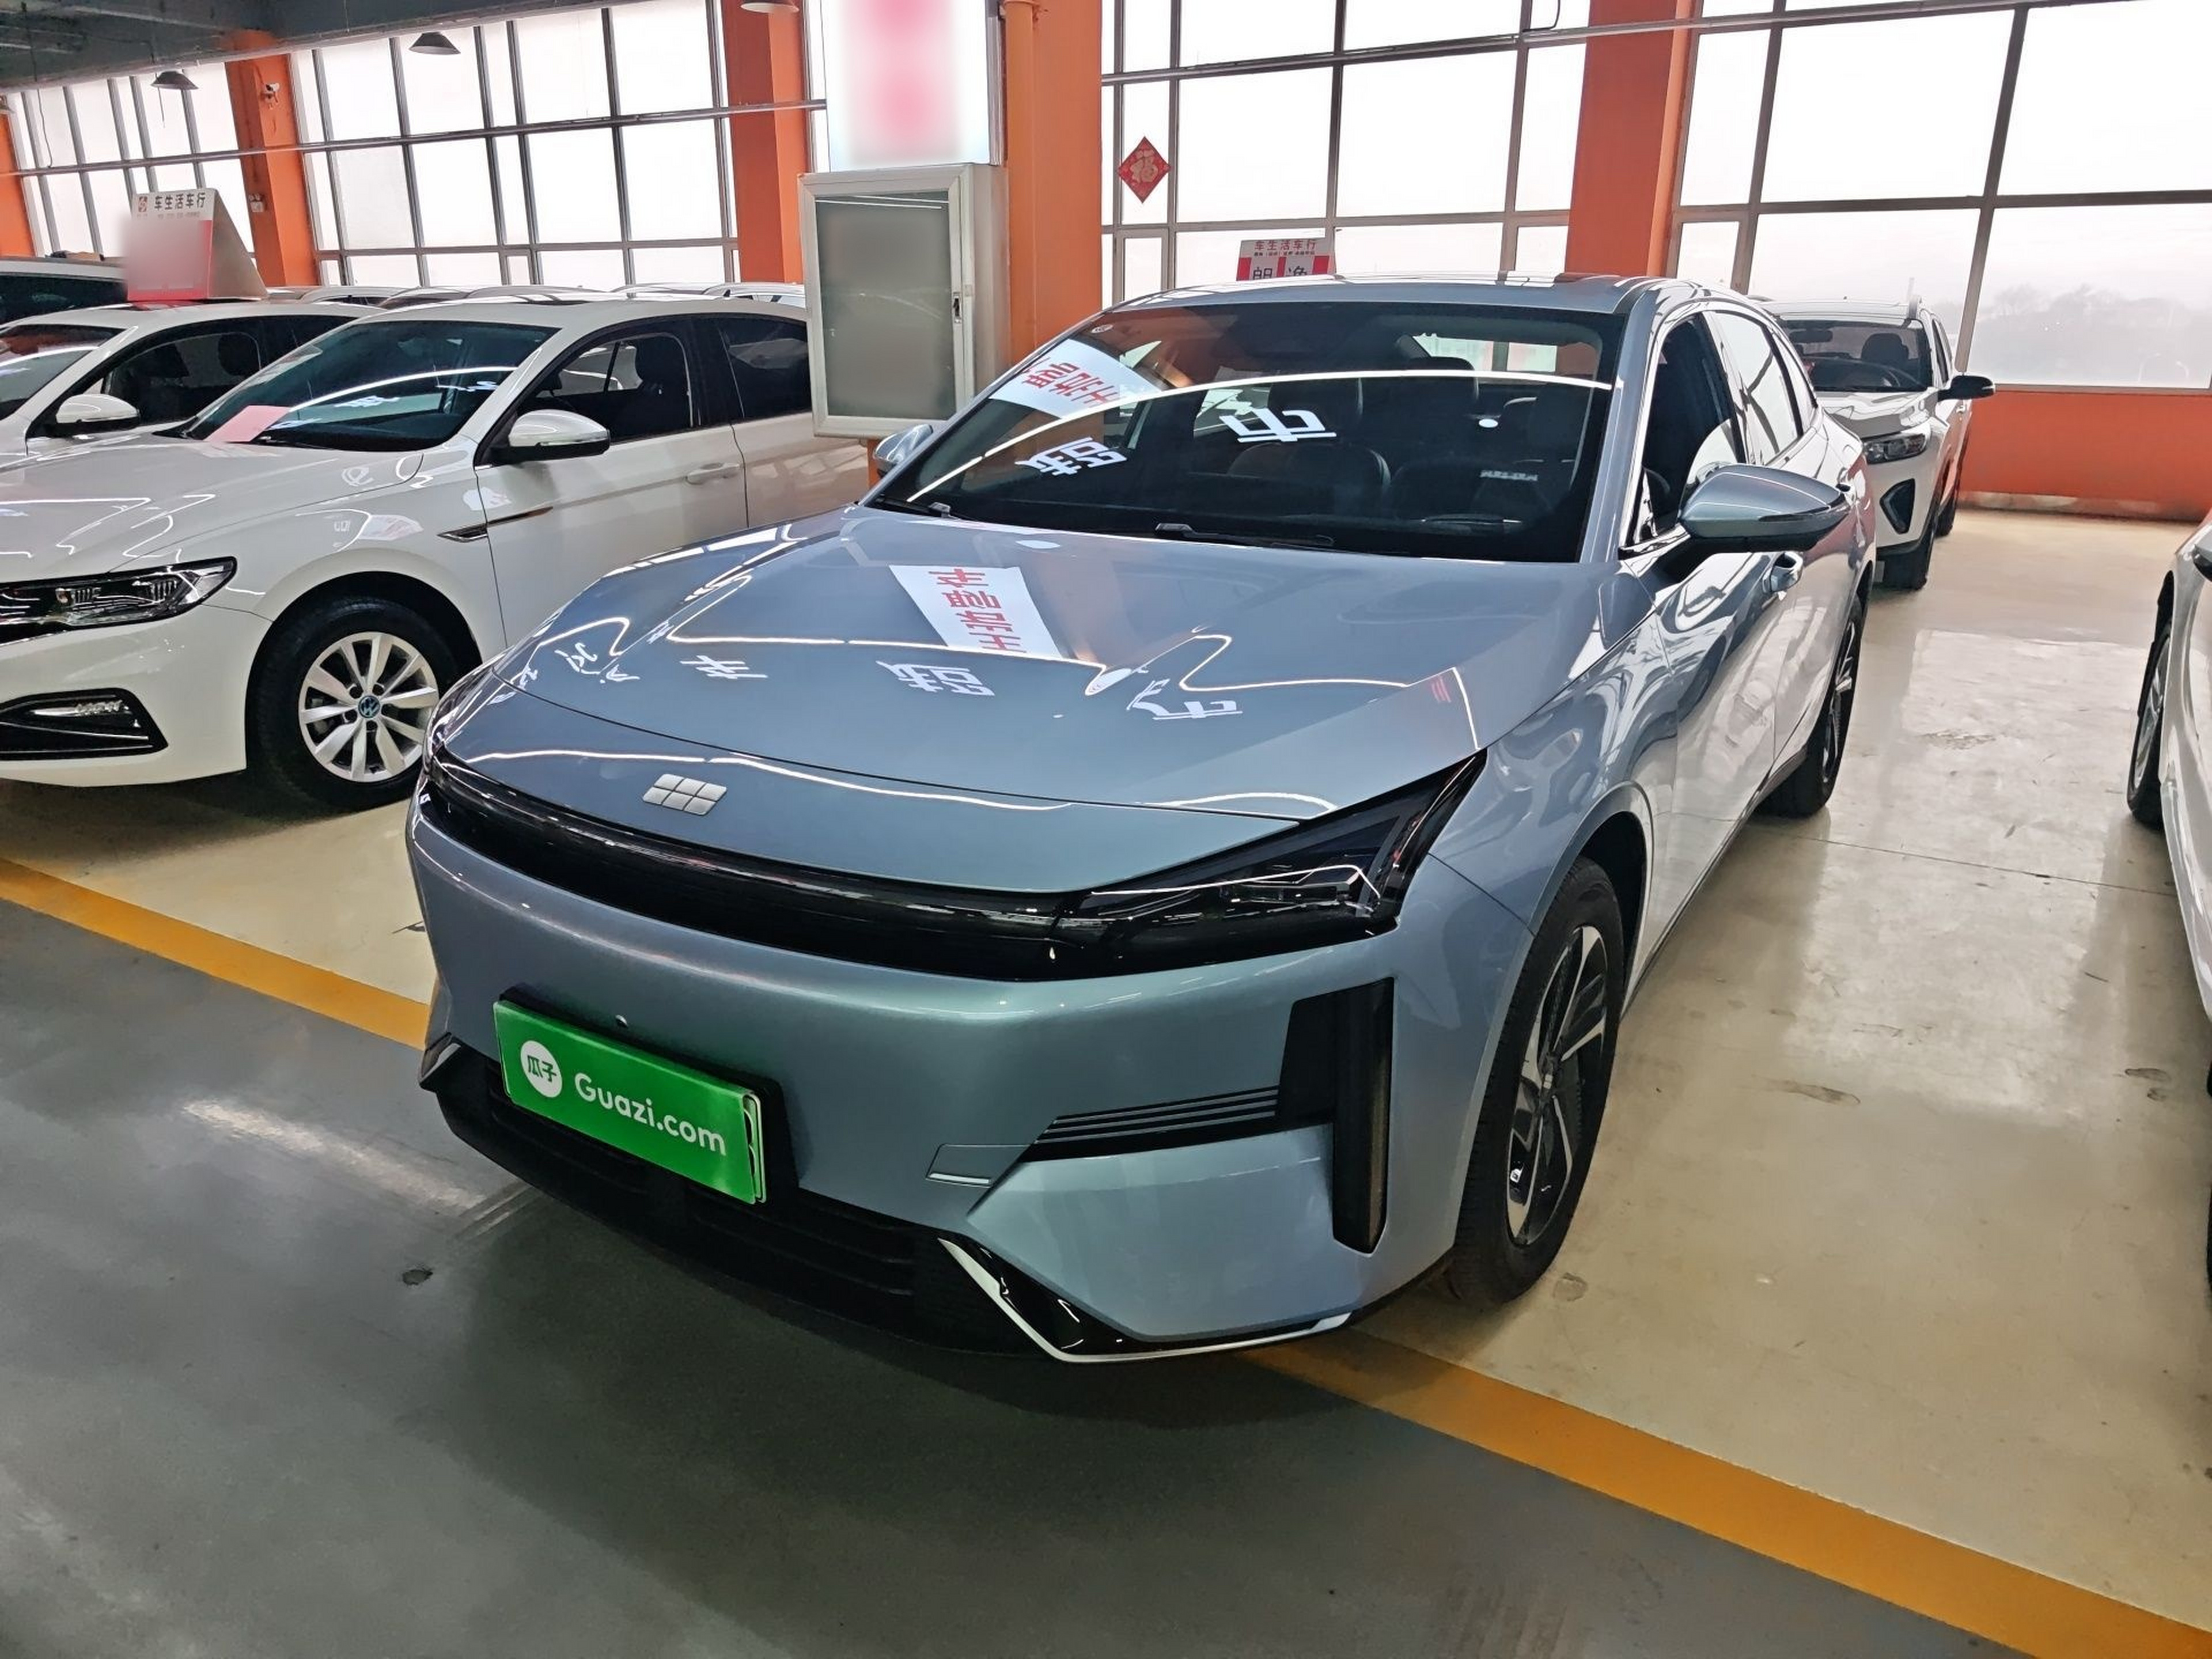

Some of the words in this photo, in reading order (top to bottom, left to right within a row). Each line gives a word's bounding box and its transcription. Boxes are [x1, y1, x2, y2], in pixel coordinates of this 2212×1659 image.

[154, 192, 206, 210] 车生活车行
[1254, 239, 1316, 251] 车生活车行
[527, 1055, 557, 1083] 瓜子
[574, 1073, 726, 1156] Guazi.com
